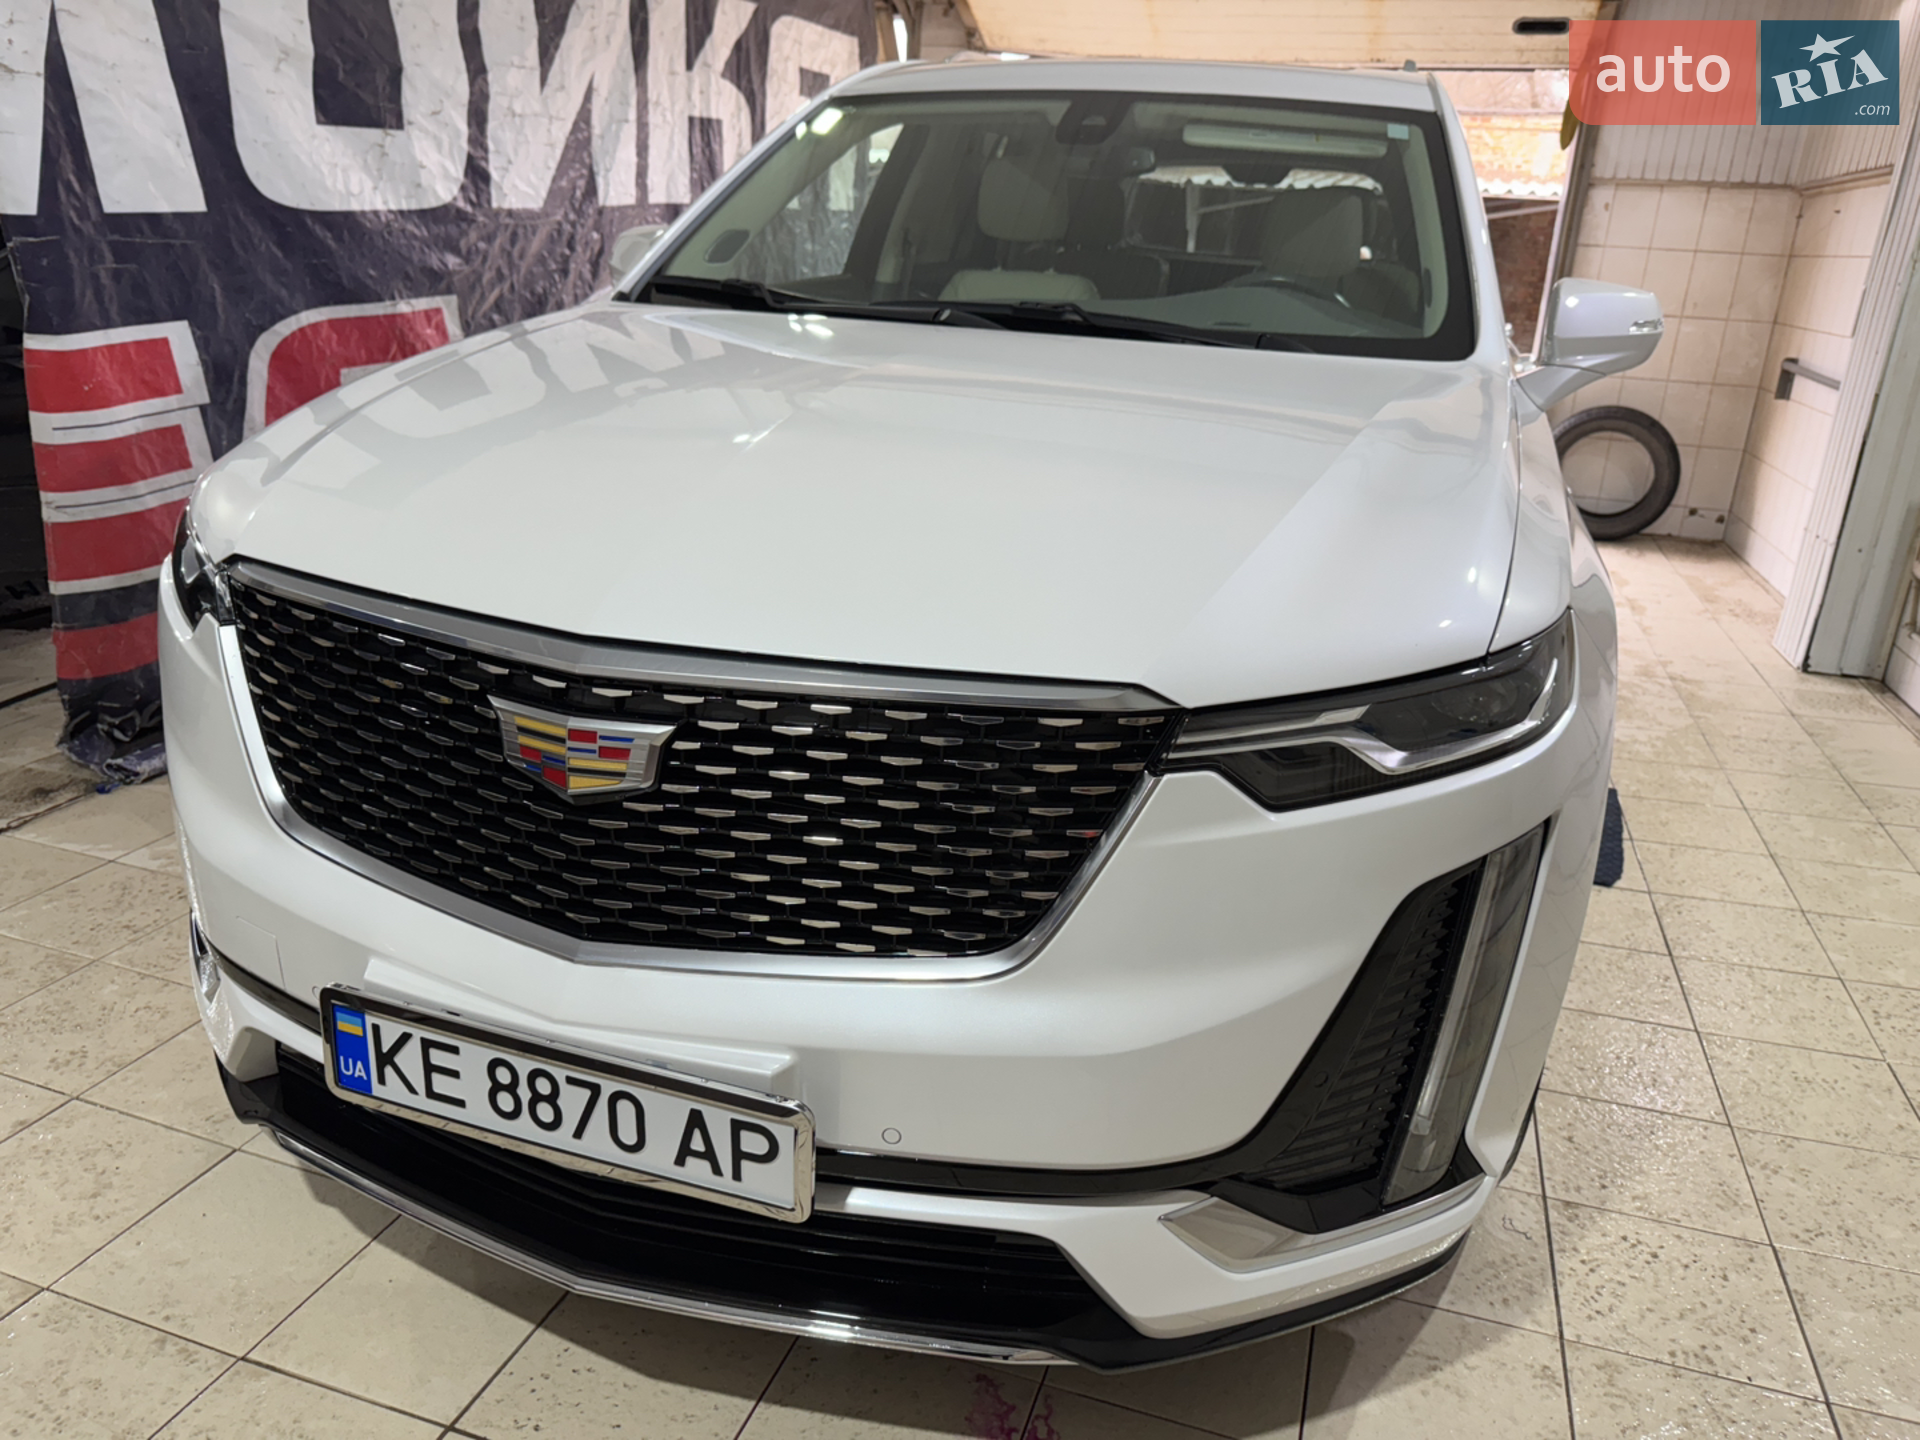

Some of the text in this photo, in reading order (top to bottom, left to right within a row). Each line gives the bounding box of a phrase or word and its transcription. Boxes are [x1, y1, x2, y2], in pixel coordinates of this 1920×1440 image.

[340, 1055, 367, 1080] UA
[371, 1022, 781, 1183] KE 8870 AP
